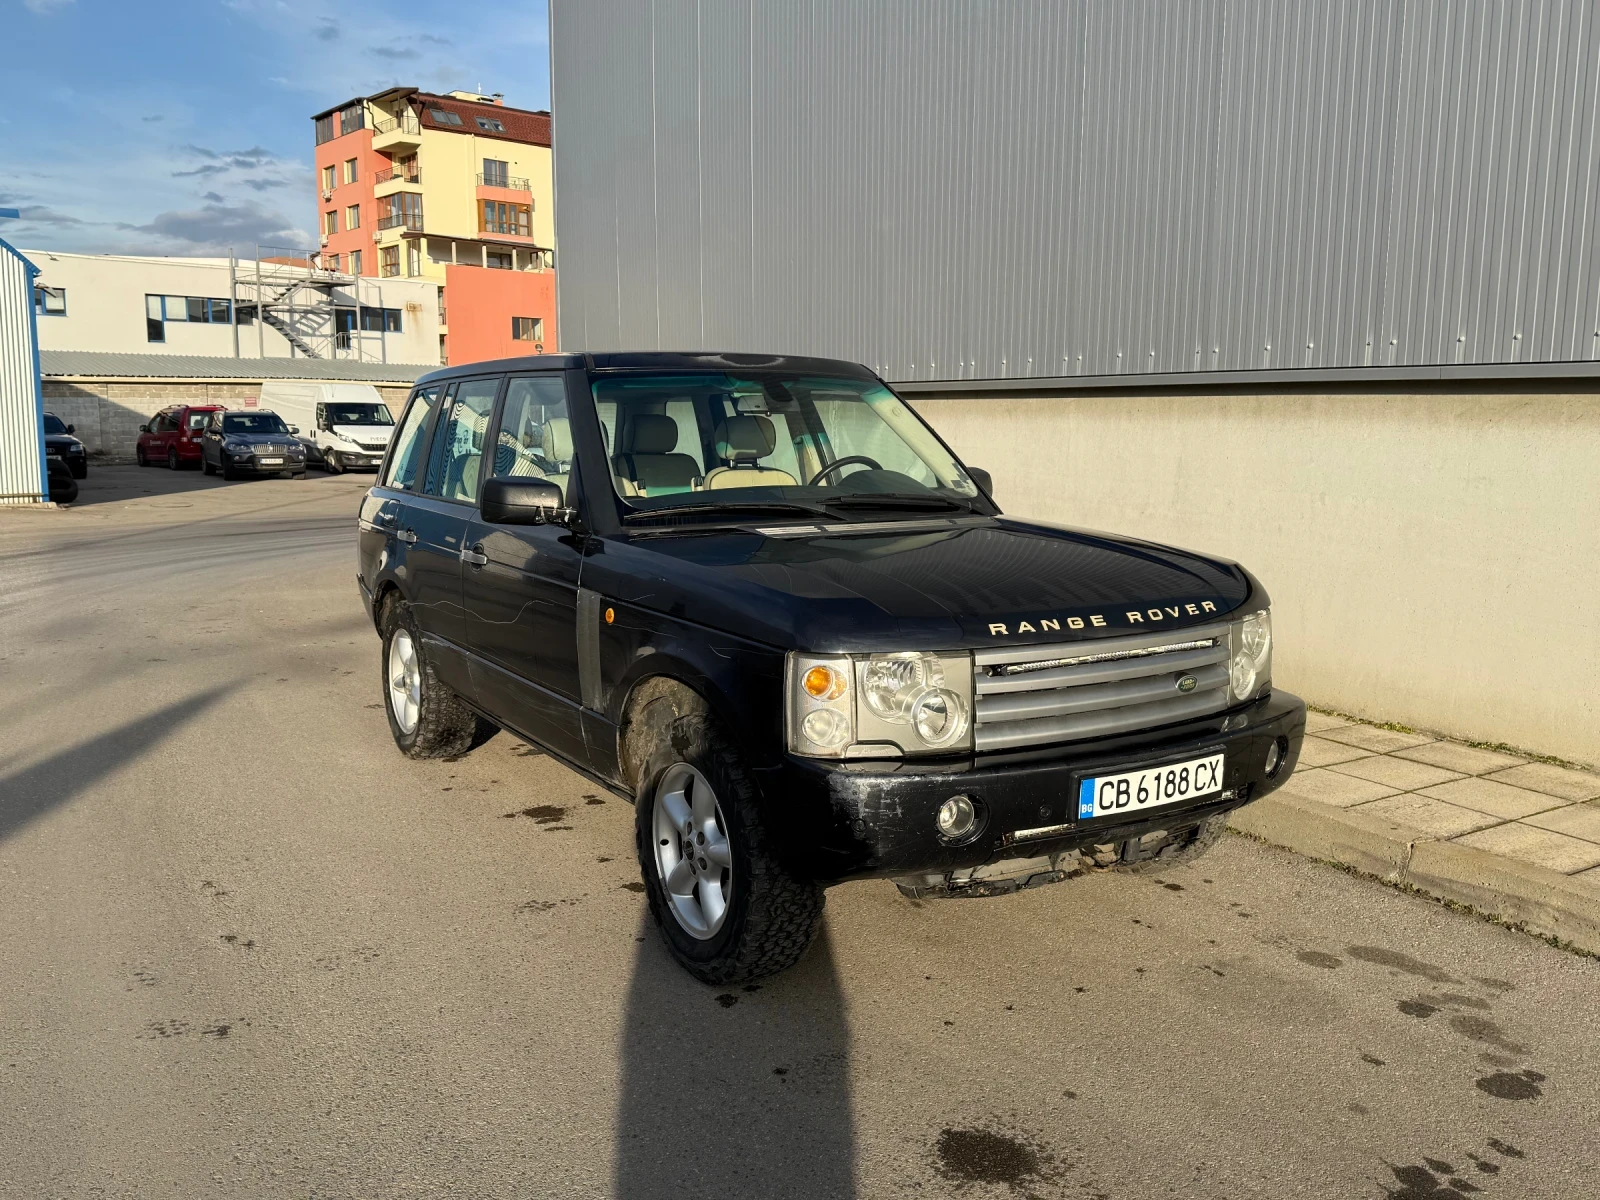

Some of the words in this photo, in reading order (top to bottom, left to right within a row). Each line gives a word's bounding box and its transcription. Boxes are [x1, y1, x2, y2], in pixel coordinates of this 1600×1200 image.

[988, 615, 1107, 636] RANGE
[1126, 600, 1217, 624] ROVER
[1098, 779, 1131, 811] CB
[1136, 767, 1190, 804] 6188
[1194, 759, 1220, 793] CX
[1081, 804, 1093, 813] BG
